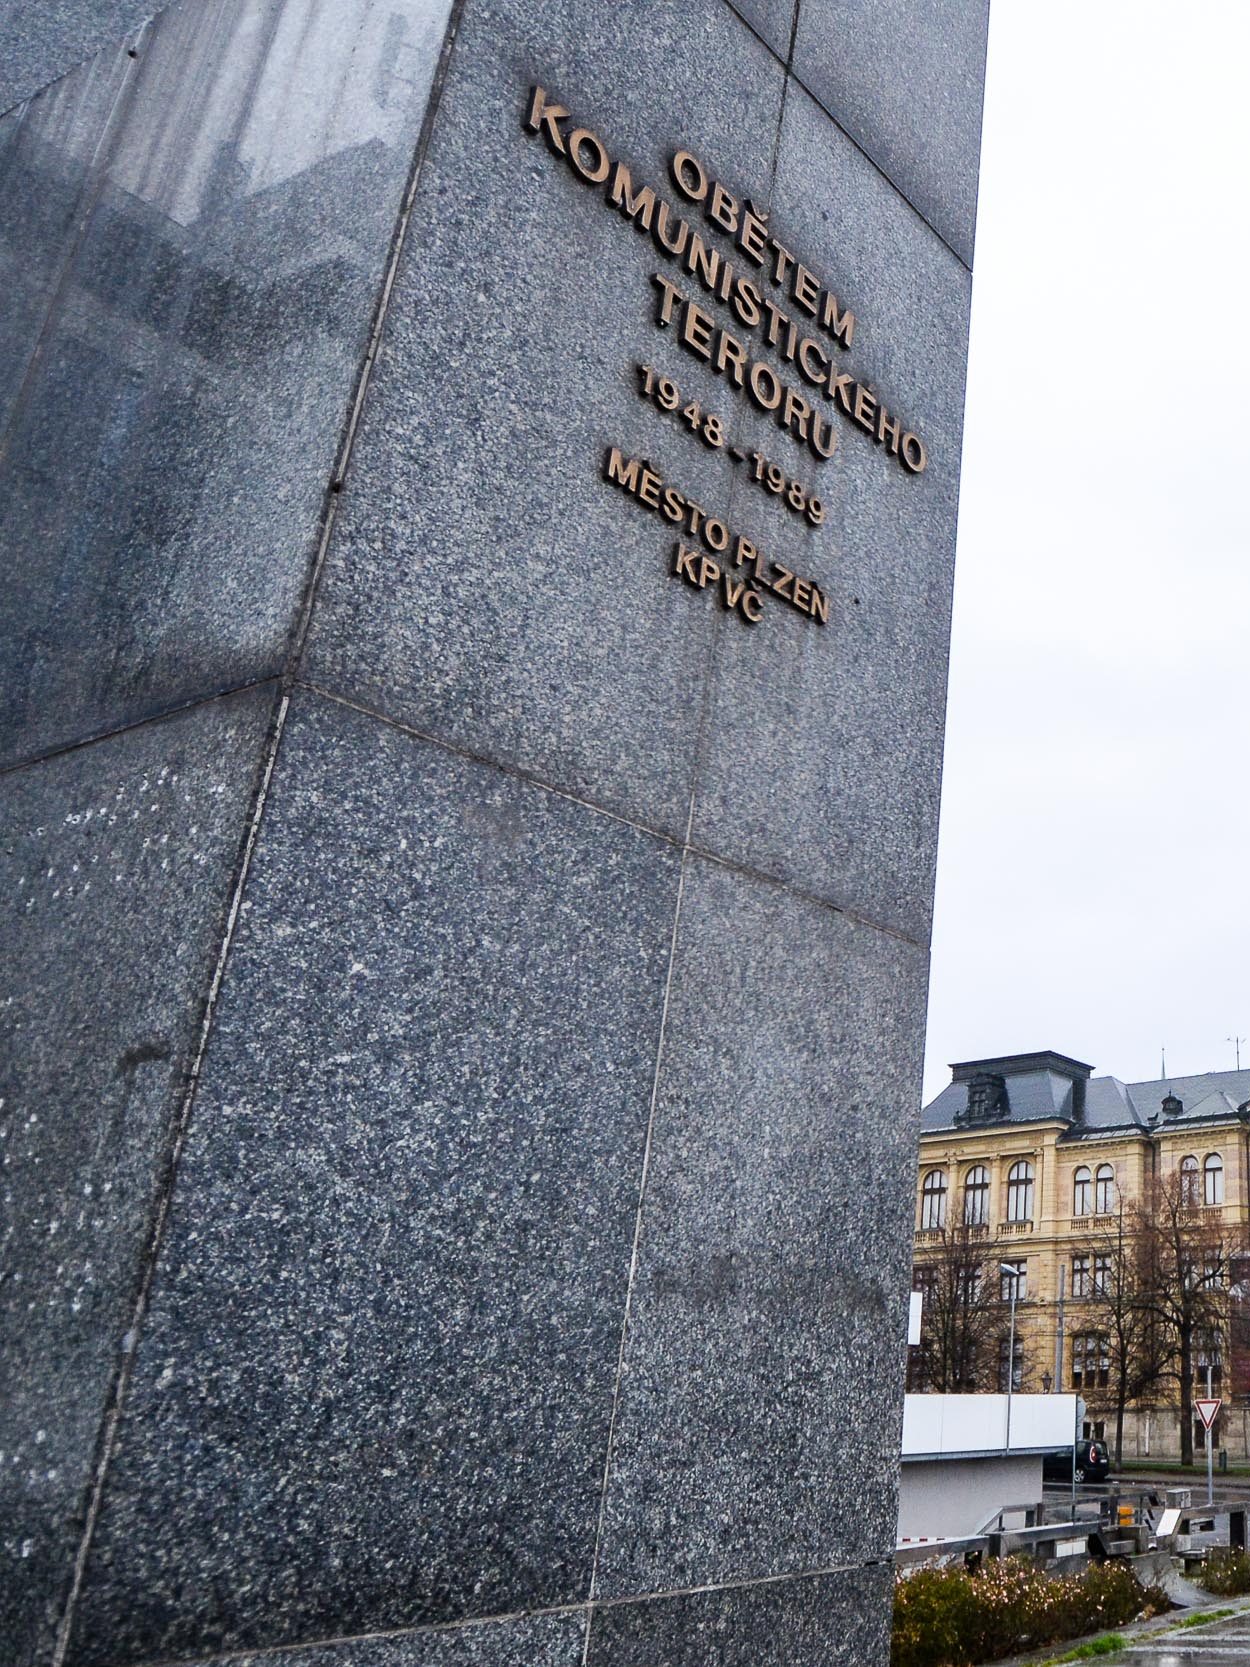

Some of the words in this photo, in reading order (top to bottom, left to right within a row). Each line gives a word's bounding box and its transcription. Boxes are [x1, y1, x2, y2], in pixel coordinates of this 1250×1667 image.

[527, 85, 928, 473] KOMUNISTICKÉHO
[671, 151, 856, 350] OBĚTEM
[639, 365, 725, 447] 1948
[751, 452, 826, 525] 1989
[653, 273, 839, 459] TERORU
[605, 447, 729, 551] MĚSTO
[735, 536, 831, 625] PLZEŇ
